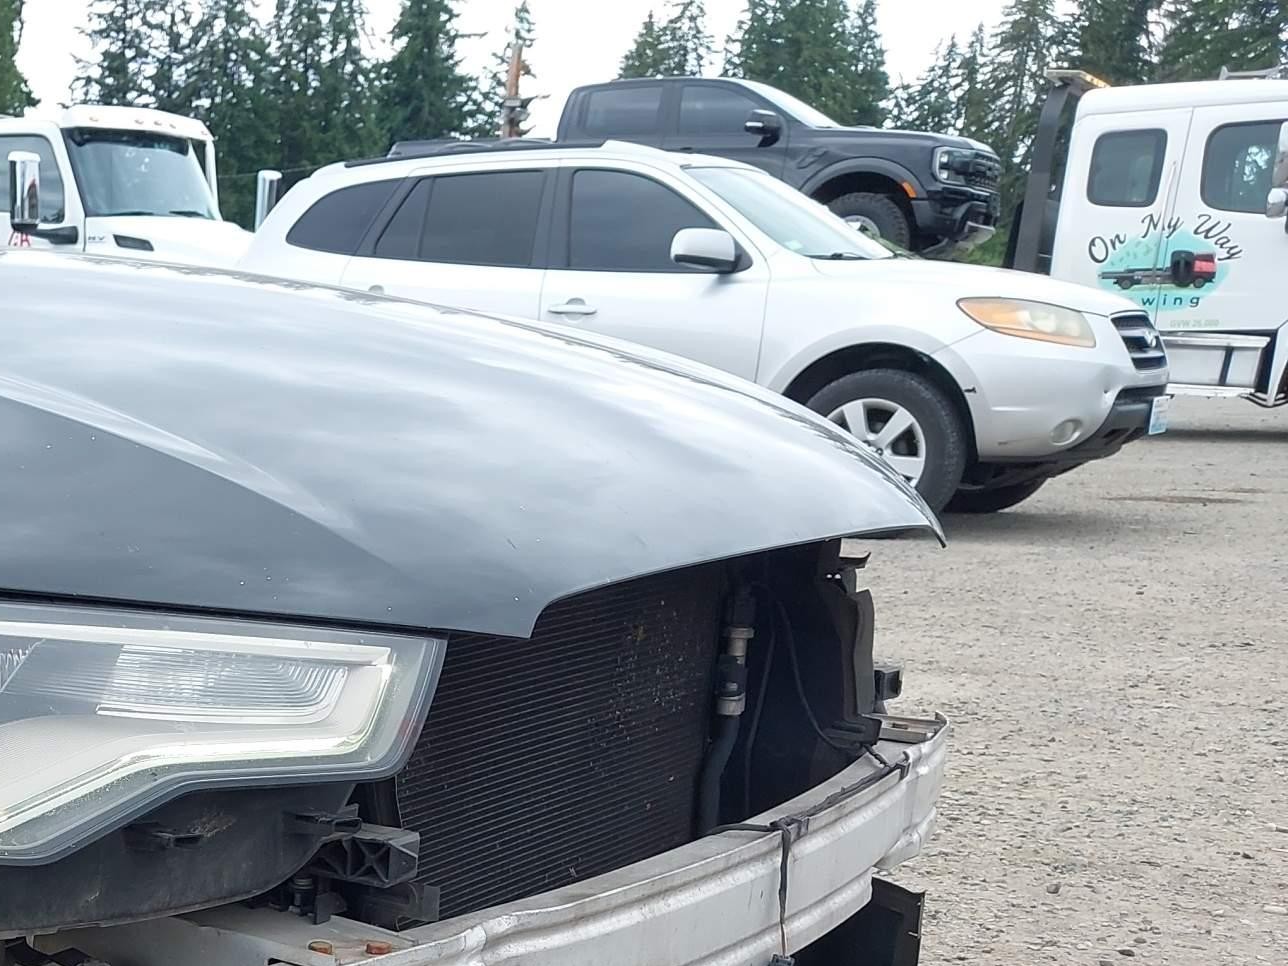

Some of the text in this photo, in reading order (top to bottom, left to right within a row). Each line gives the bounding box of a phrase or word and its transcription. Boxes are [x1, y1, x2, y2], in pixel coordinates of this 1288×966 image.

[1088, 213, 1243, 264] On My Way
[1141, 294, 1201, 308] wing
